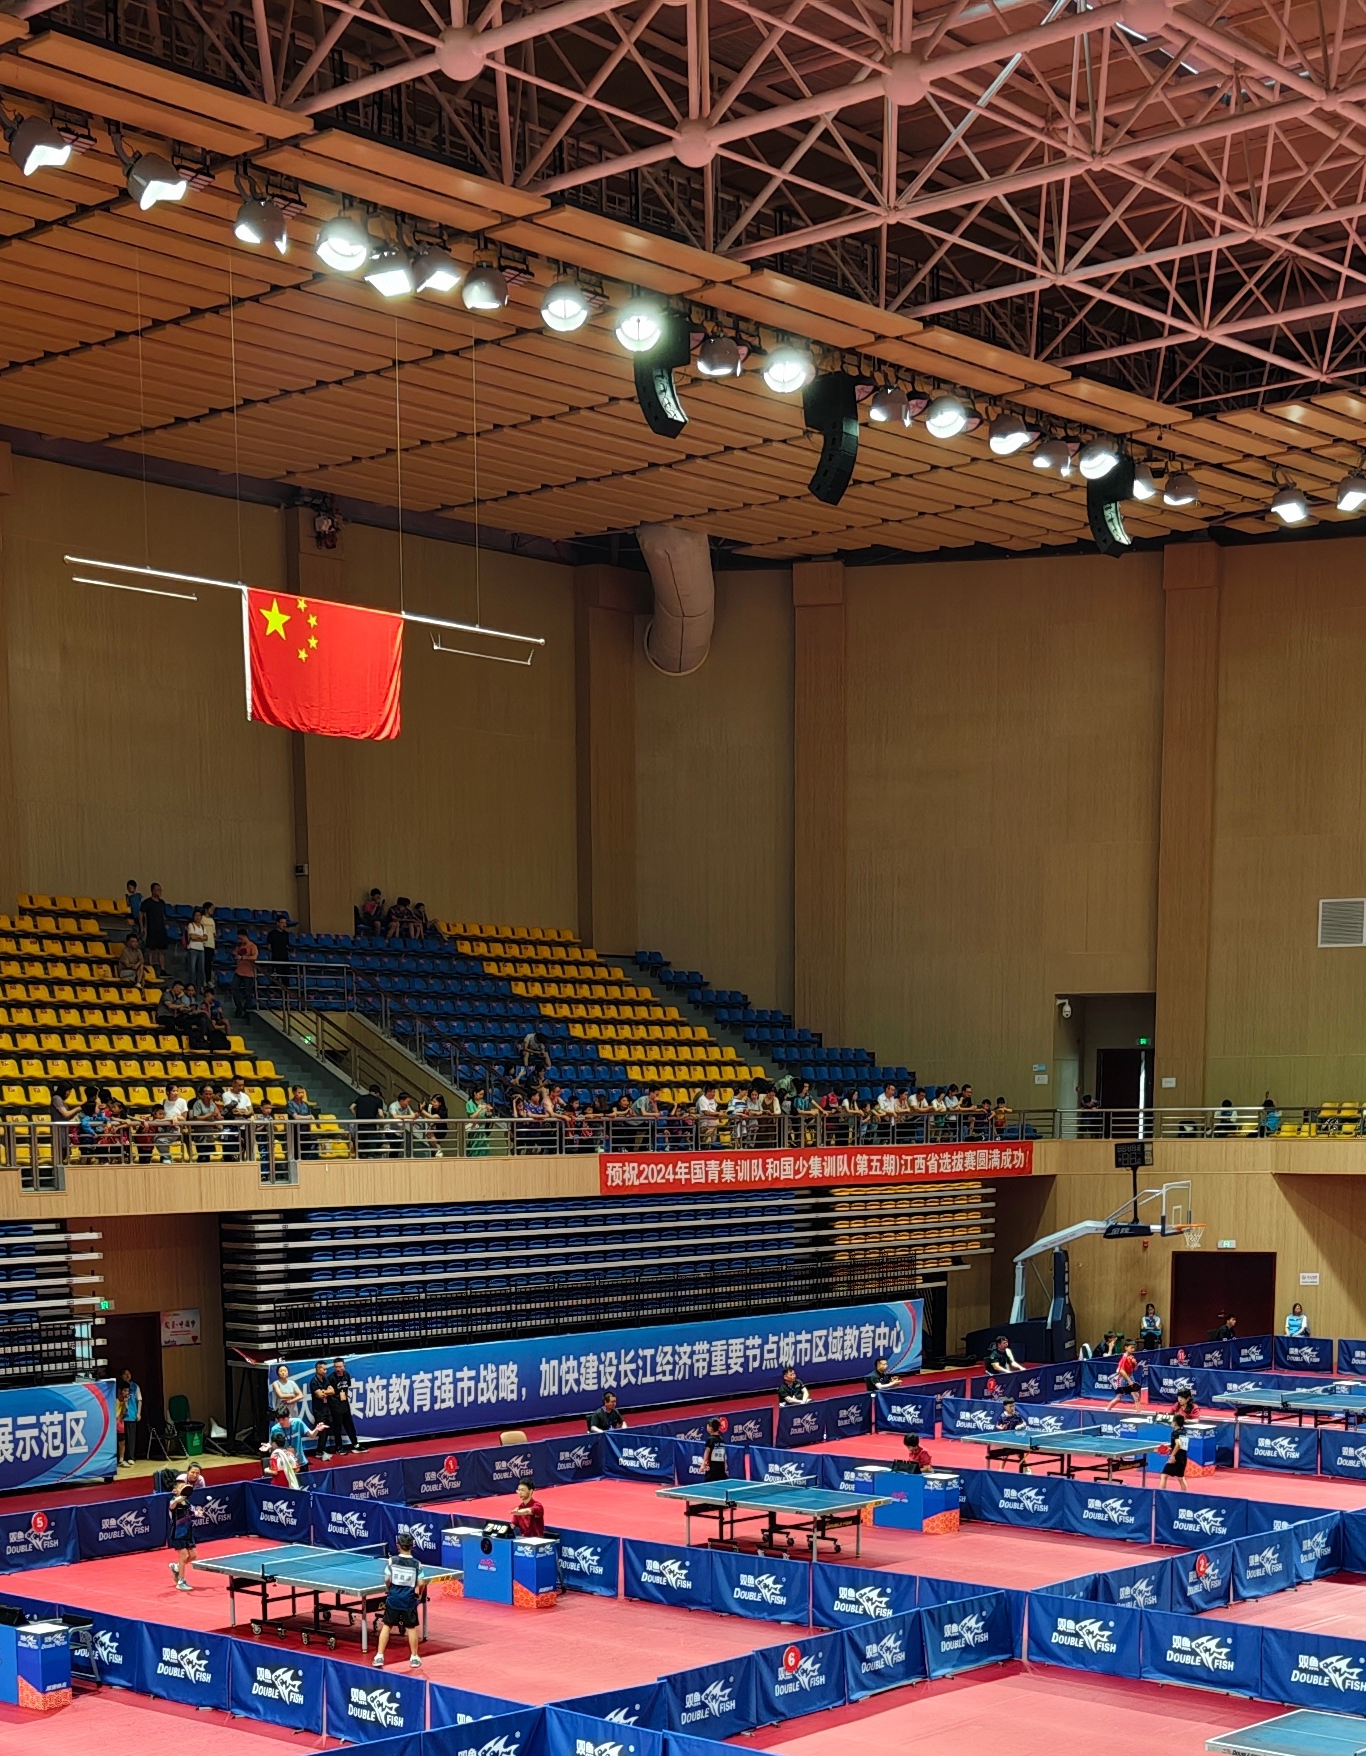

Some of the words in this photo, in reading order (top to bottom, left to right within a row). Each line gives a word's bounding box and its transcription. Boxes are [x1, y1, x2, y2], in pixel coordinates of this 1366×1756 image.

[36, 1516, 44, 1528] 5
[641, 1572, 667, 1585] DOUBLE
[676, 1579, 692, 1589] FISH
[1051, 1632, 1084, 1647] DOUBLE
[1096, 1641, 1116, 1653] FISH
[788, 1652, 796, 1666] 6
[1291, 1670, 1330, 1686] DOUBLE
[1345, 1679, 1366, 1692] FISH
